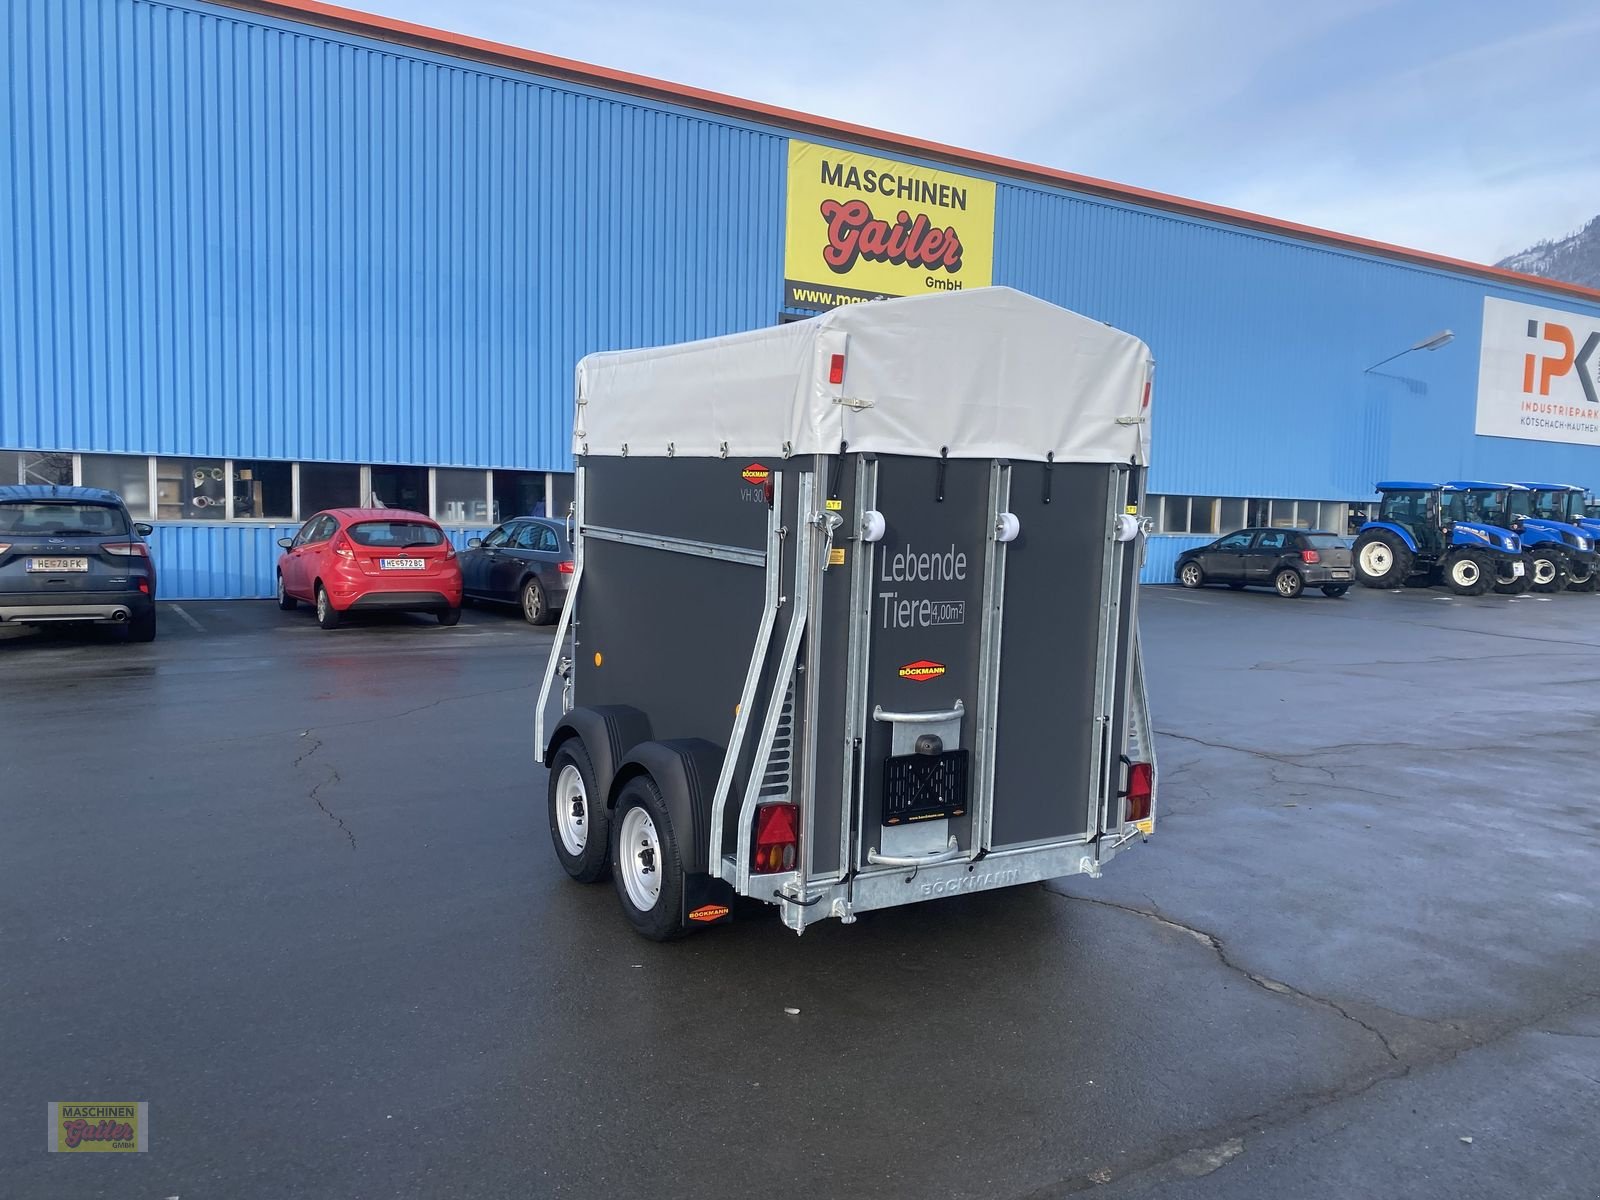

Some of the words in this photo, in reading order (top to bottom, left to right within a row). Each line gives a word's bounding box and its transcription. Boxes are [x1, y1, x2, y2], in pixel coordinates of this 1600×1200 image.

[821, 160, 967, 211] MASCHINEN
[820, 199, 963, 274] Gailer
[925, 276, 962, 291] GmbH
[1521, 401, 1599, 419] INDUSTRIEPARK
[741, 488, 752, 501] VH
[881, 543, 967, 582] Lebende
[879, 592, 931, 629] Tiere
[899, 667, 945, 676] BÖCKMANN
